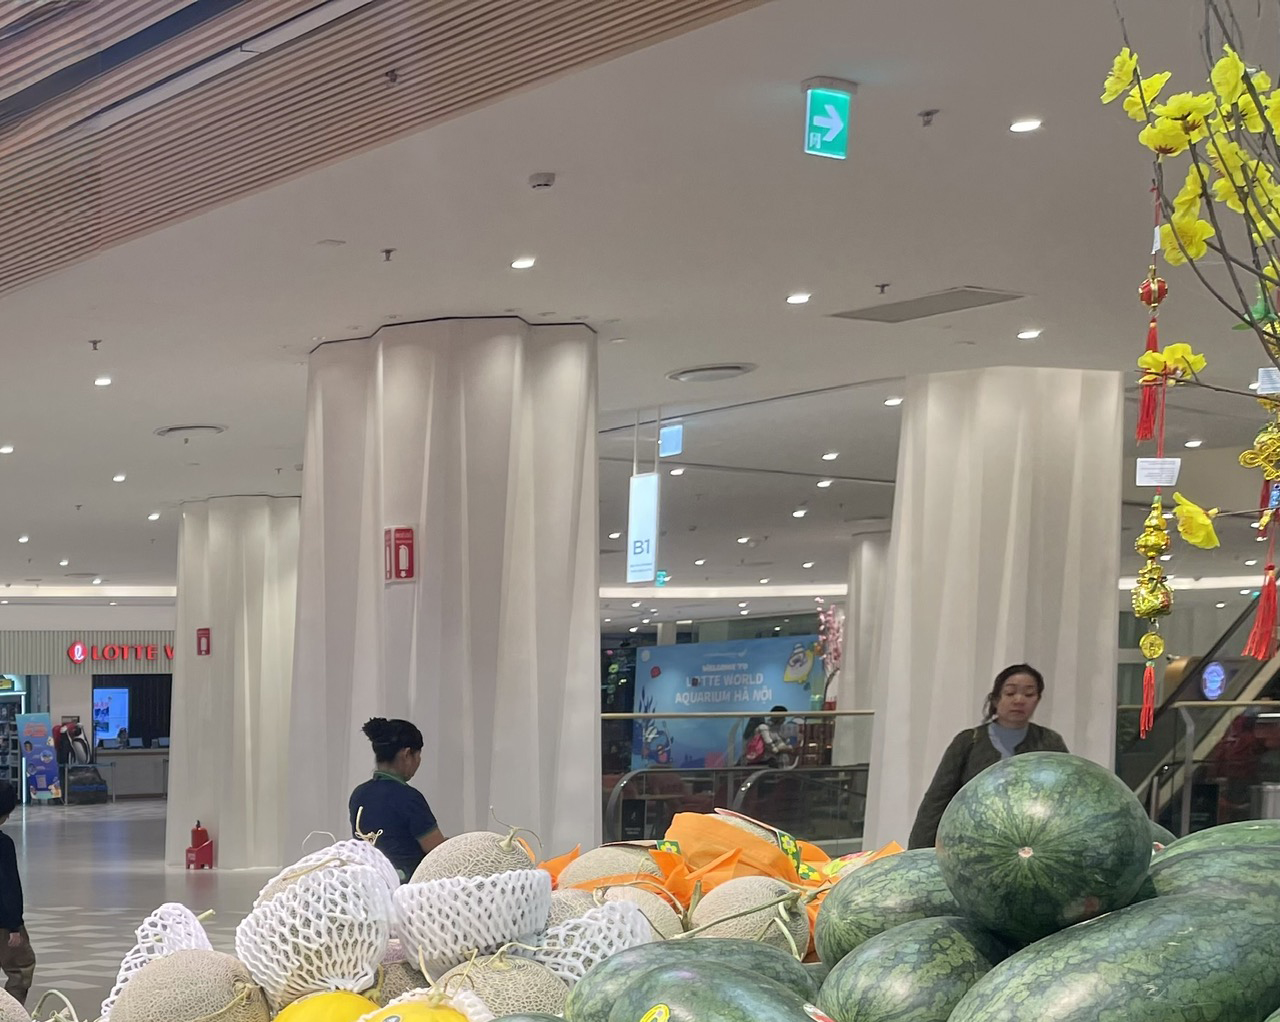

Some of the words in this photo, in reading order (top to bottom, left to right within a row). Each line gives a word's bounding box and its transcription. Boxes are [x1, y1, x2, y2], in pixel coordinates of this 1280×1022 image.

[633, 539, 650, 555] B1
[91, 645, 159, 660] LOTTE
[723, 672, 764, 685] WORLD
[675, 691, 731, 704] AQUARIUM
